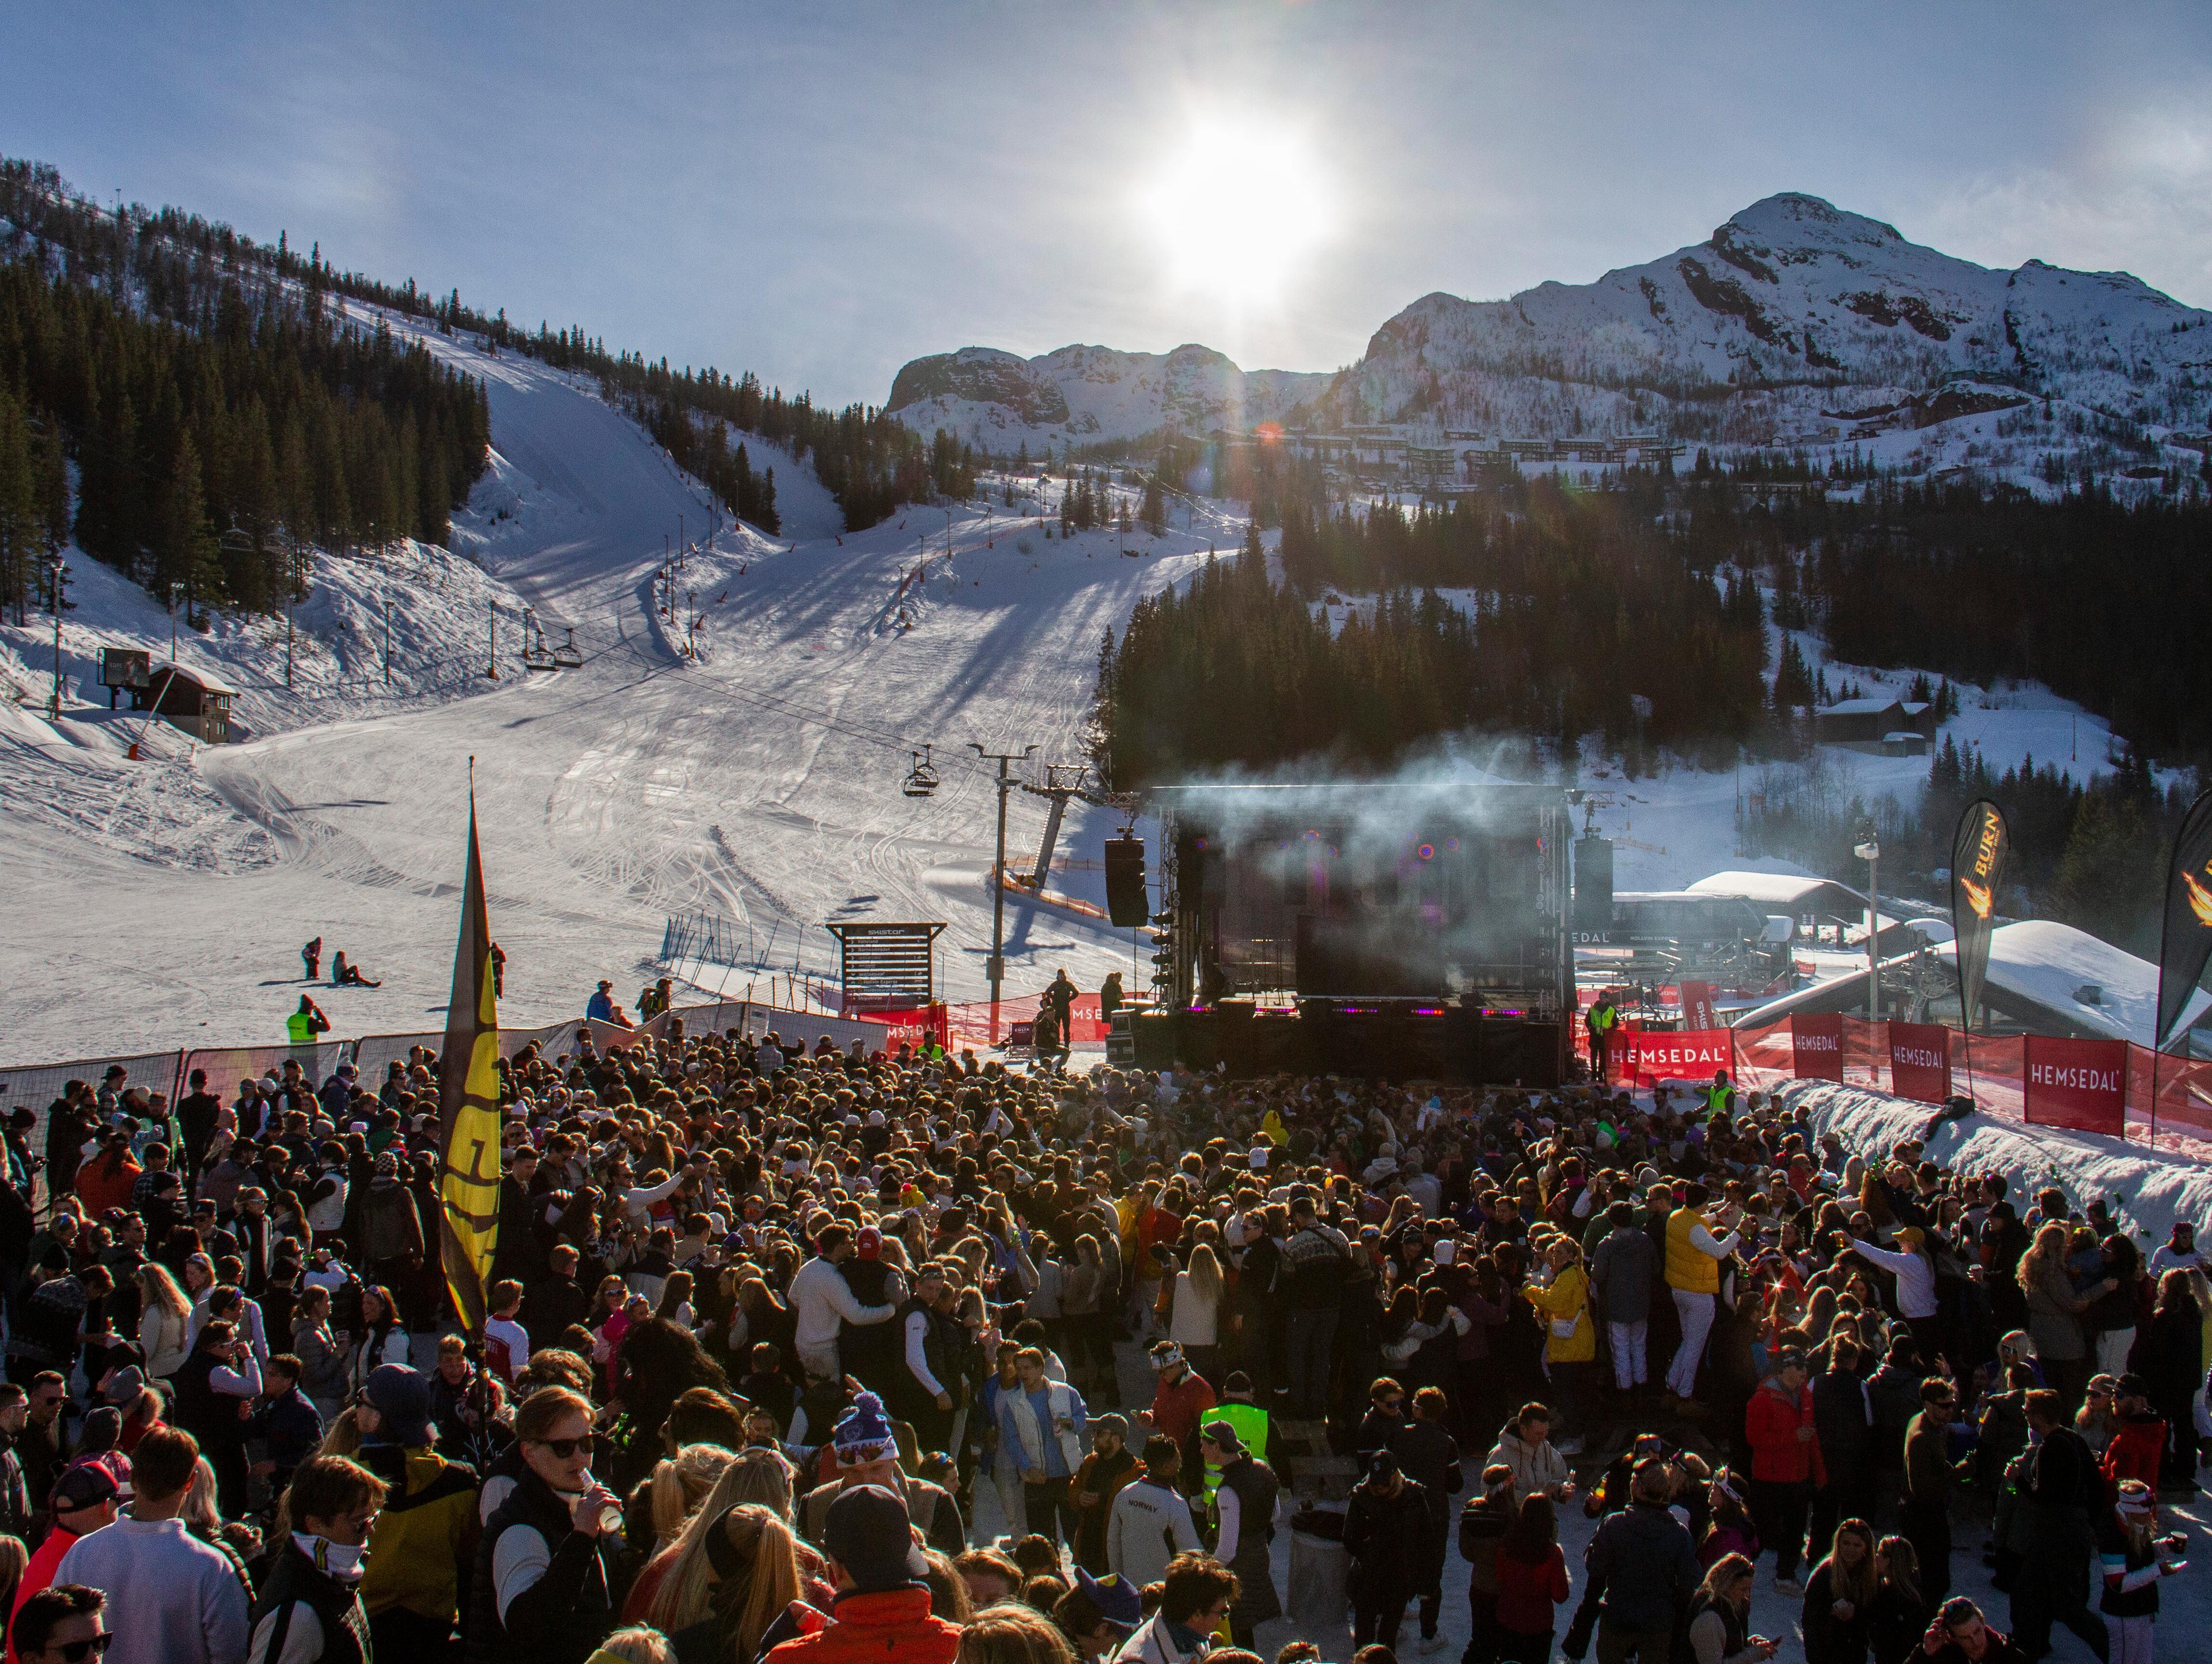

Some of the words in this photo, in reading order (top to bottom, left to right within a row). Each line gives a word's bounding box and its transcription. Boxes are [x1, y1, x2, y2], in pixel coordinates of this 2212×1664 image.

[1975, 811, 2000, 876] BURN
[1796, 1035, 1838, 1050] HEMSEDAL
[1611, 1047, 1724, 1063] HEMSEDAL
[2032, 1064, 2118, 1091] HEMSEDAL
[1128, 1499, 1158, 1513] NORWAY
